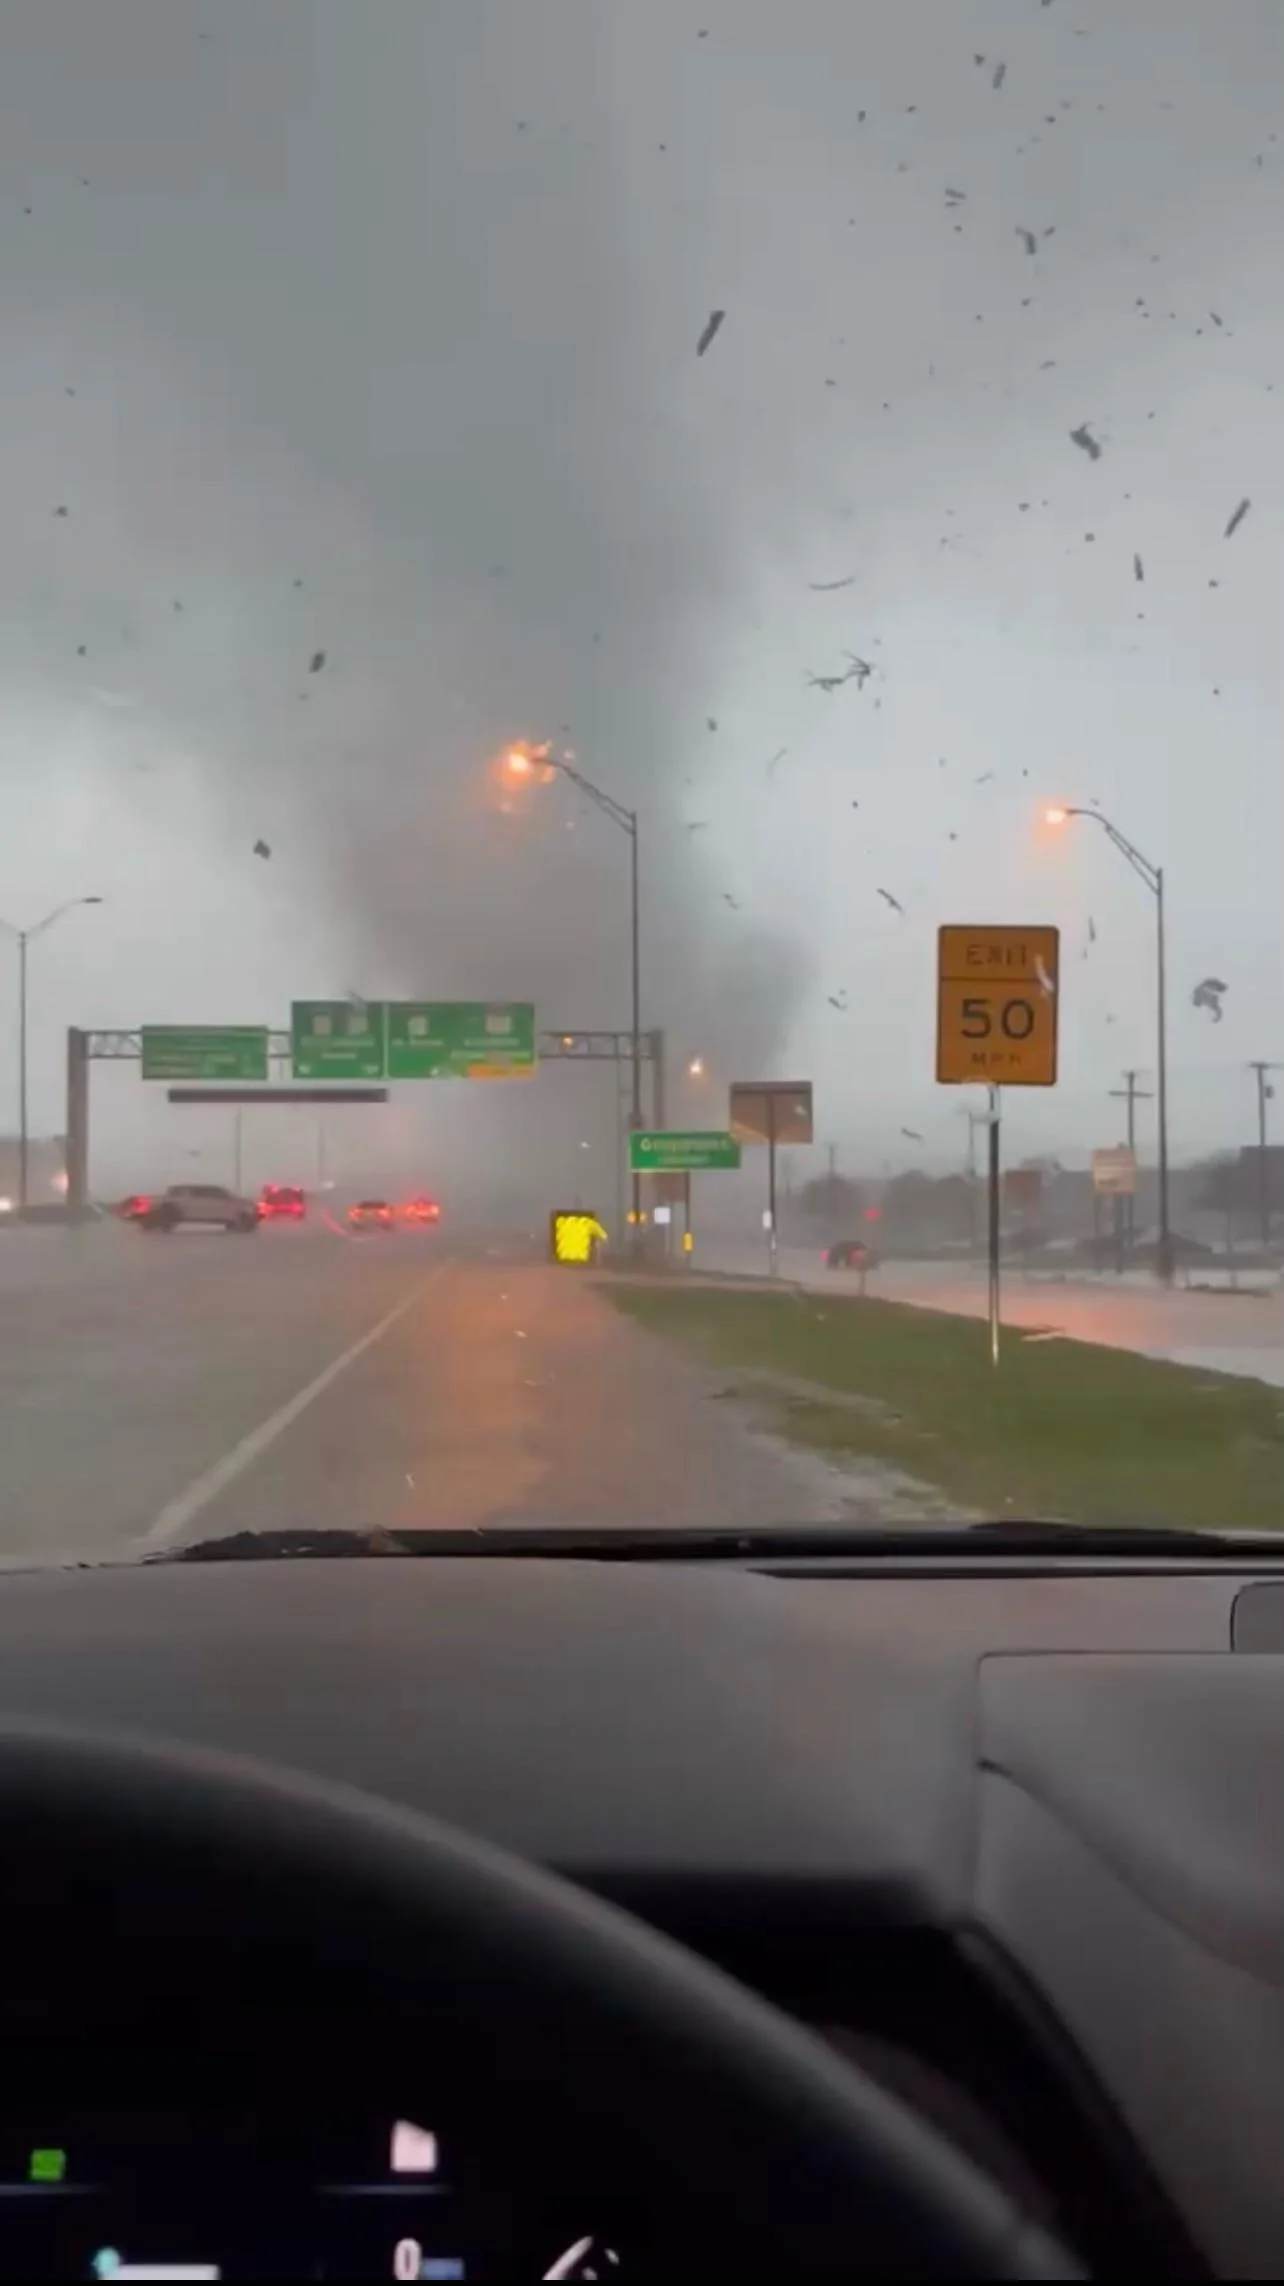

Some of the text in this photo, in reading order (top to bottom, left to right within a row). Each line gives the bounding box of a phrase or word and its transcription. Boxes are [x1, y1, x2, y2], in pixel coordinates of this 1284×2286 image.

[965, 943, 1028, 967] EXIT
[961, 998, 1035, 1040] 50
[971, 1052, 1022, 1066] MPH
